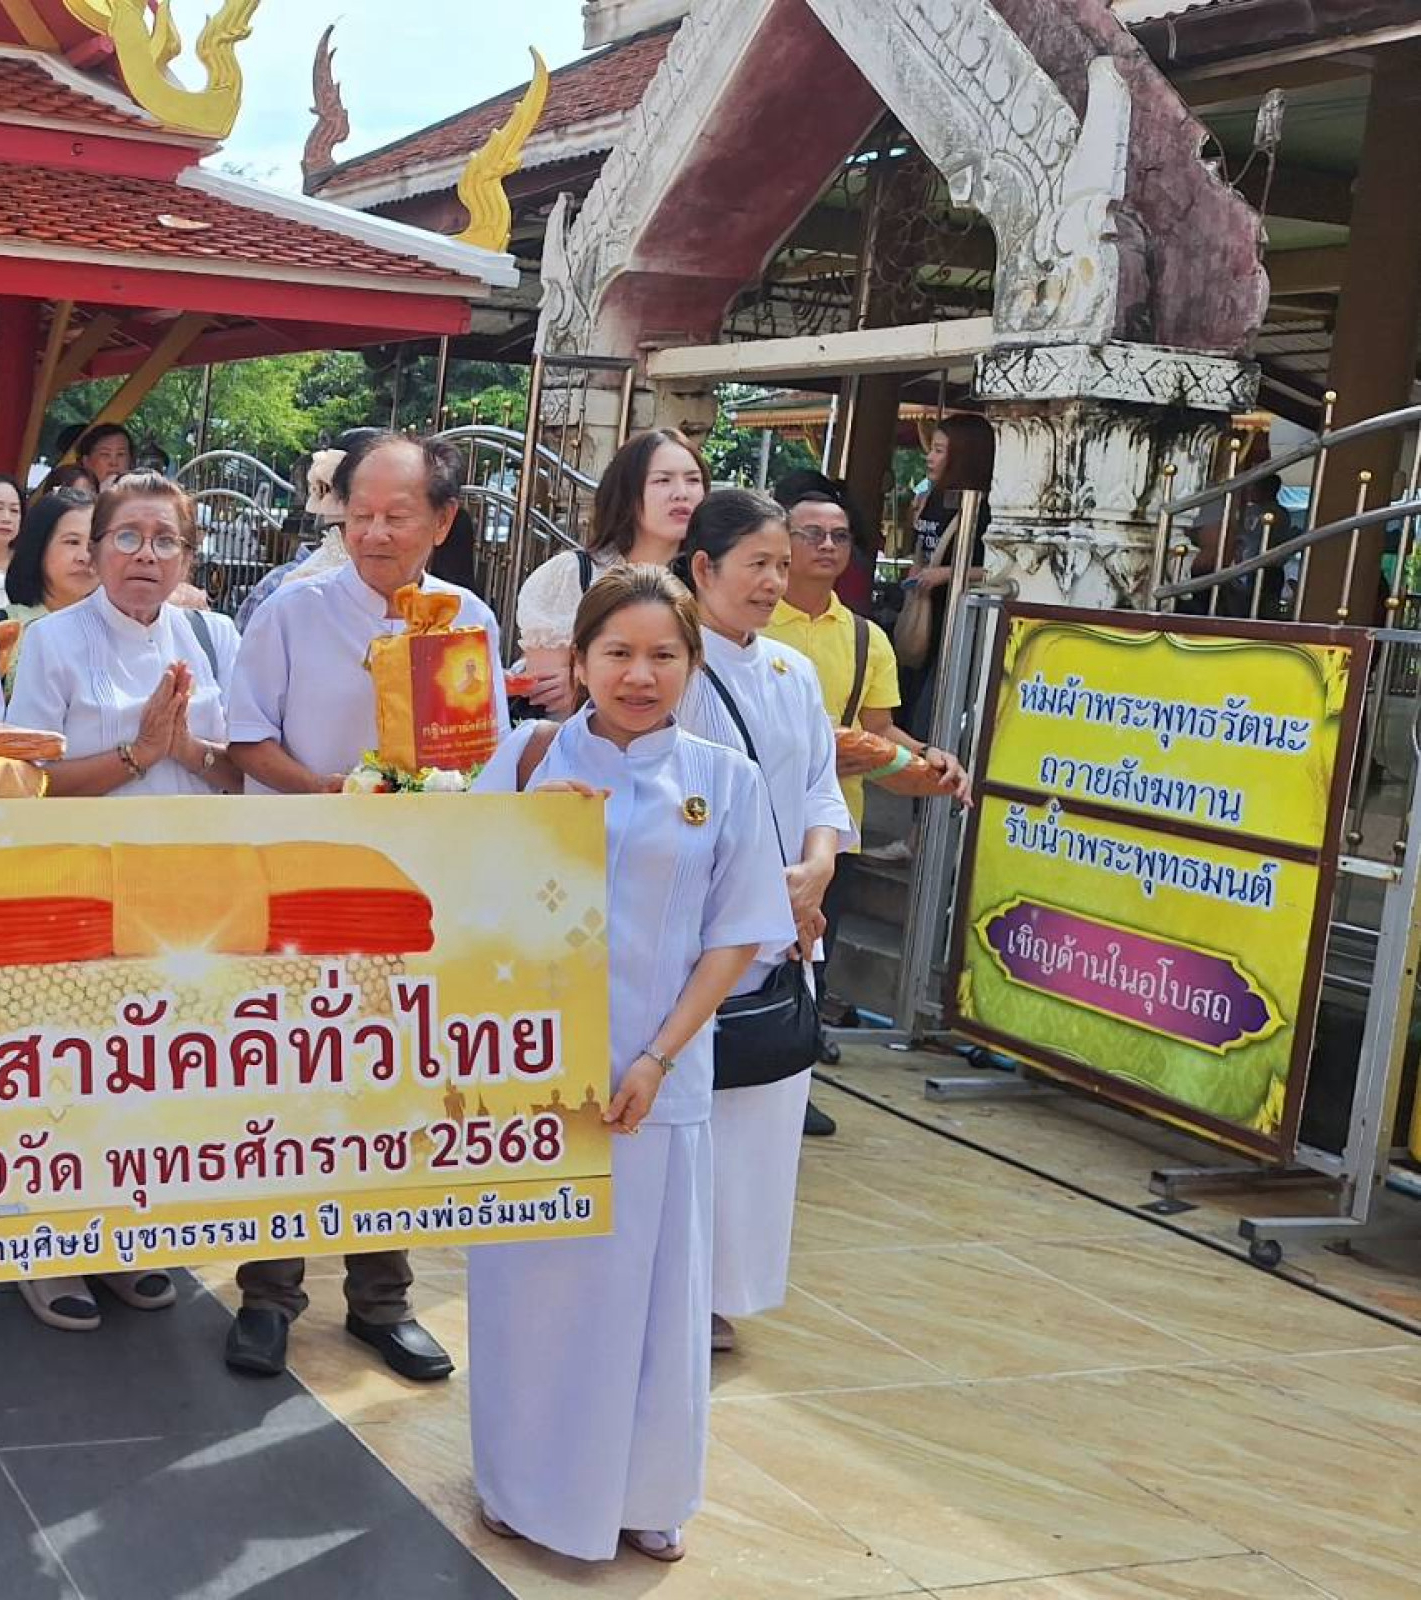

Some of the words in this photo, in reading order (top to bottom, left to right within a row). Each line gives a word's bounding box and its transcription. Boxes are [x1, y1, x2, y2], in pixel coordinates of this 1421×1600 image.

[1021, 675, 1309, 750] ห่มผ้าพระพุทธรัตนะ
[1040, 756, 1241, 821] ถวายสังฆทาน
[1005, 803, 1277, 906] รับน้ำพระพุทธมนต์
[1007, 924, 1232, 1024] เชิญด้านในอุโบสถ
[106, 1119, 407, 1208] พุทธศักราช
[431, 1117, 561, 1168] 2568
[115, 1222, 256, 1262] บูชาธรรม
[271, 1214, 306, 1239] 81
[320, 1204, 340, 1236] ปี
[353, 1187, 591, 1234] หลวงพ่อธัมมชโย
